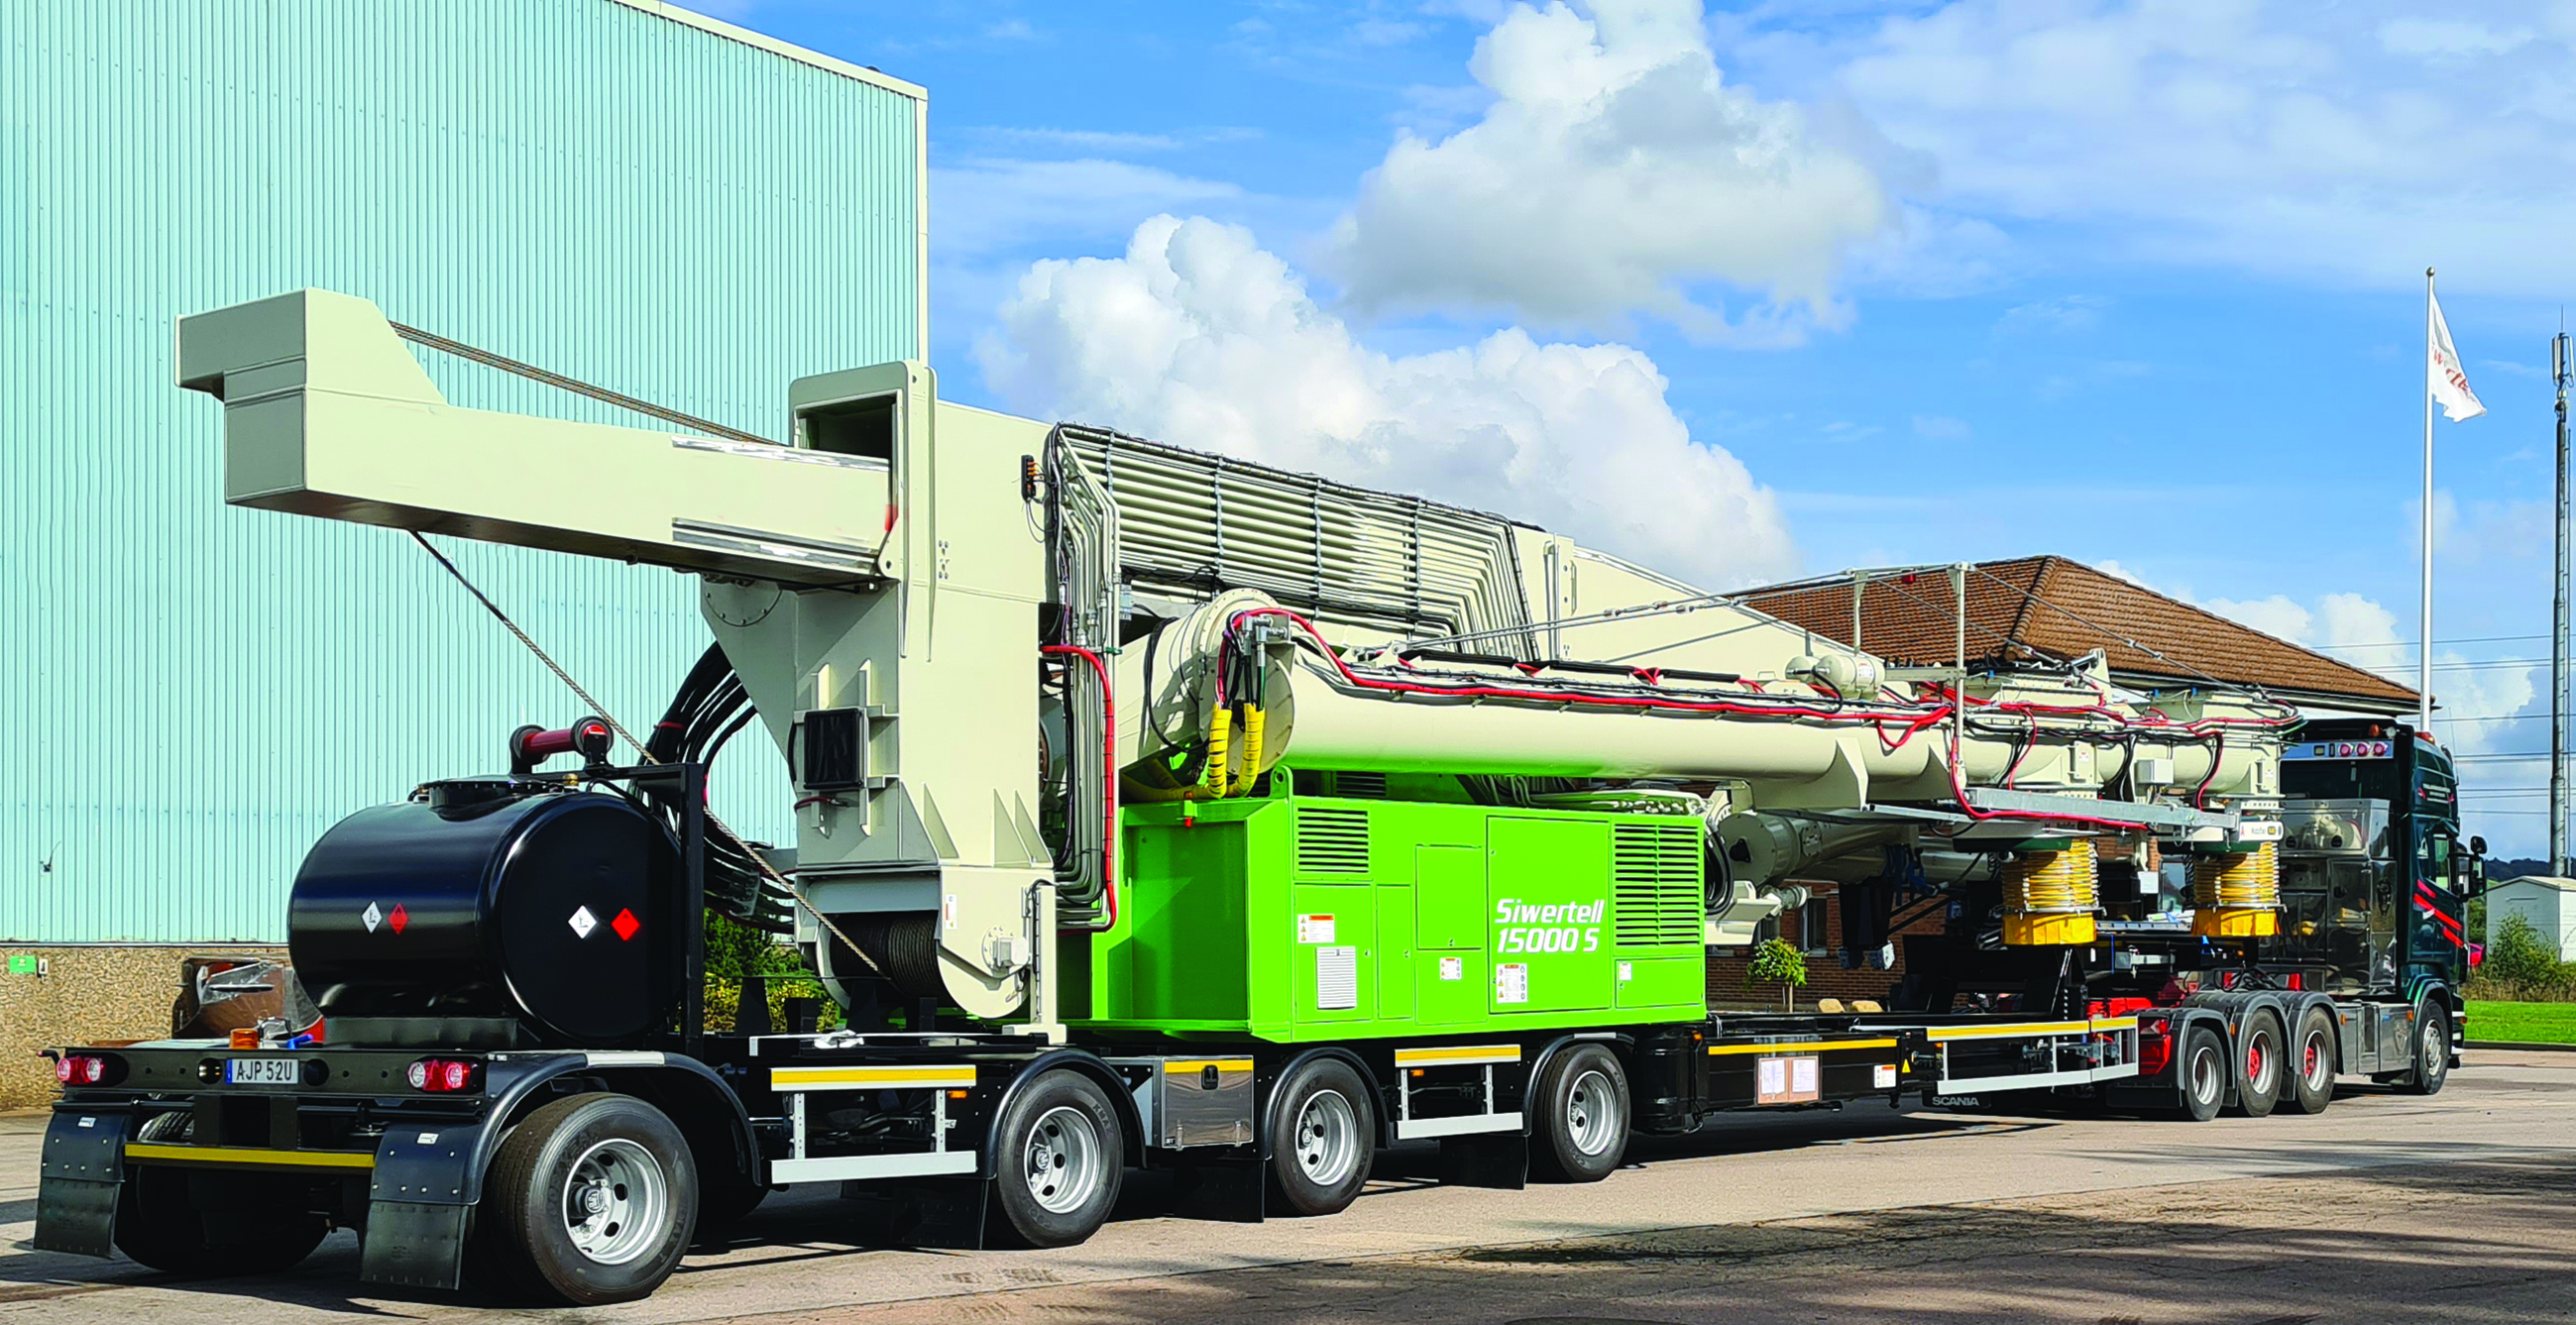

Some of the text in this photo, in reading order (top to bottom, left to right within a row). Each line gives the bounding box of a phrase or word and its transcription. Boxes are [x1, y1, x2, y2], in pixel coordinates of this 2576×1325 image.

[1494, 898, 1606, 924] Siwertell
[1497, 927, 1601, 953] 15000 S
[236, 1060, 292, 1081] AJP 52U
[1932, 1096, 1979, 1106] SCANIA
